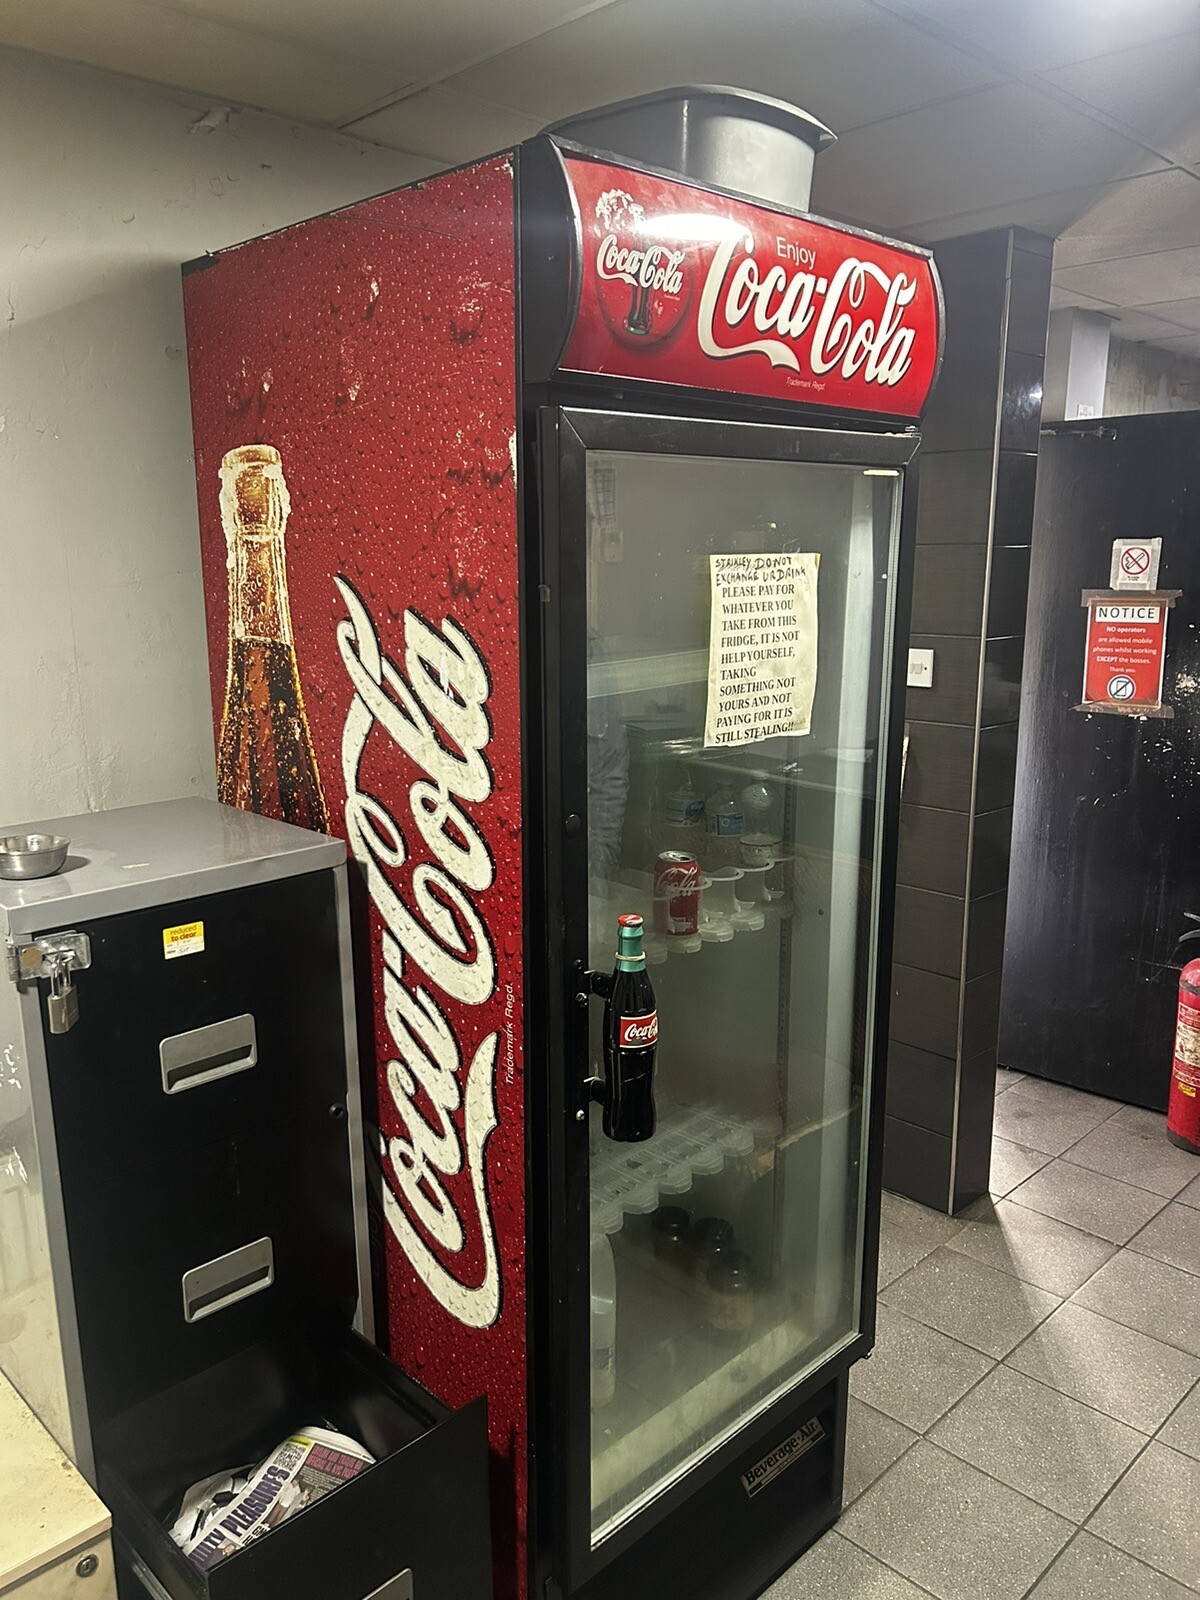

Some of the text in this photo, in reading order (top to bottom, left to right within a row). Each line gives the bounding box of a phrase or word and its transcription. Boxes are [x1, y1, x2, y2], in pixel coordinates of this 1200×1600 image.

[776, 237, 817, 271] Enjoy
[597, 234, 685, 295] Coca-Cola
[697, 232, 917, 387] Coca-Cola
[716, 571, 759, 586] EXCHANGE
[722, 584, 795, 598] PLEASE PAY FOR
[722, 600, 794, 614] WHATEVER YOU
[1099, 607, 1155, 619] NOTICE
[722, 615, 797, 631] TAKE FROM THIS
[721, 630, 800, 648] FRIDGE, IT IS NOT
[721, 647, 796, 664] HELP YOURSELF,
[1133, 648, 1157, 656] working
[720, 667, 757, 680] TAKING
[720, 677, 796, 697] SOMETHING NOT
[719, 692, 792, 712] YOURS AND NOT
[716, 707, 793, 728] PAYING FOR IT IS
[715, 722, 794, 744] STILL STEALING!!
[170, 924, 197, 935] reduced
[180, 932, 197, 940] clear
[333, 576, 495, 1328] Coca-Cola
[505, 1020, 515, 1085] Trademark
